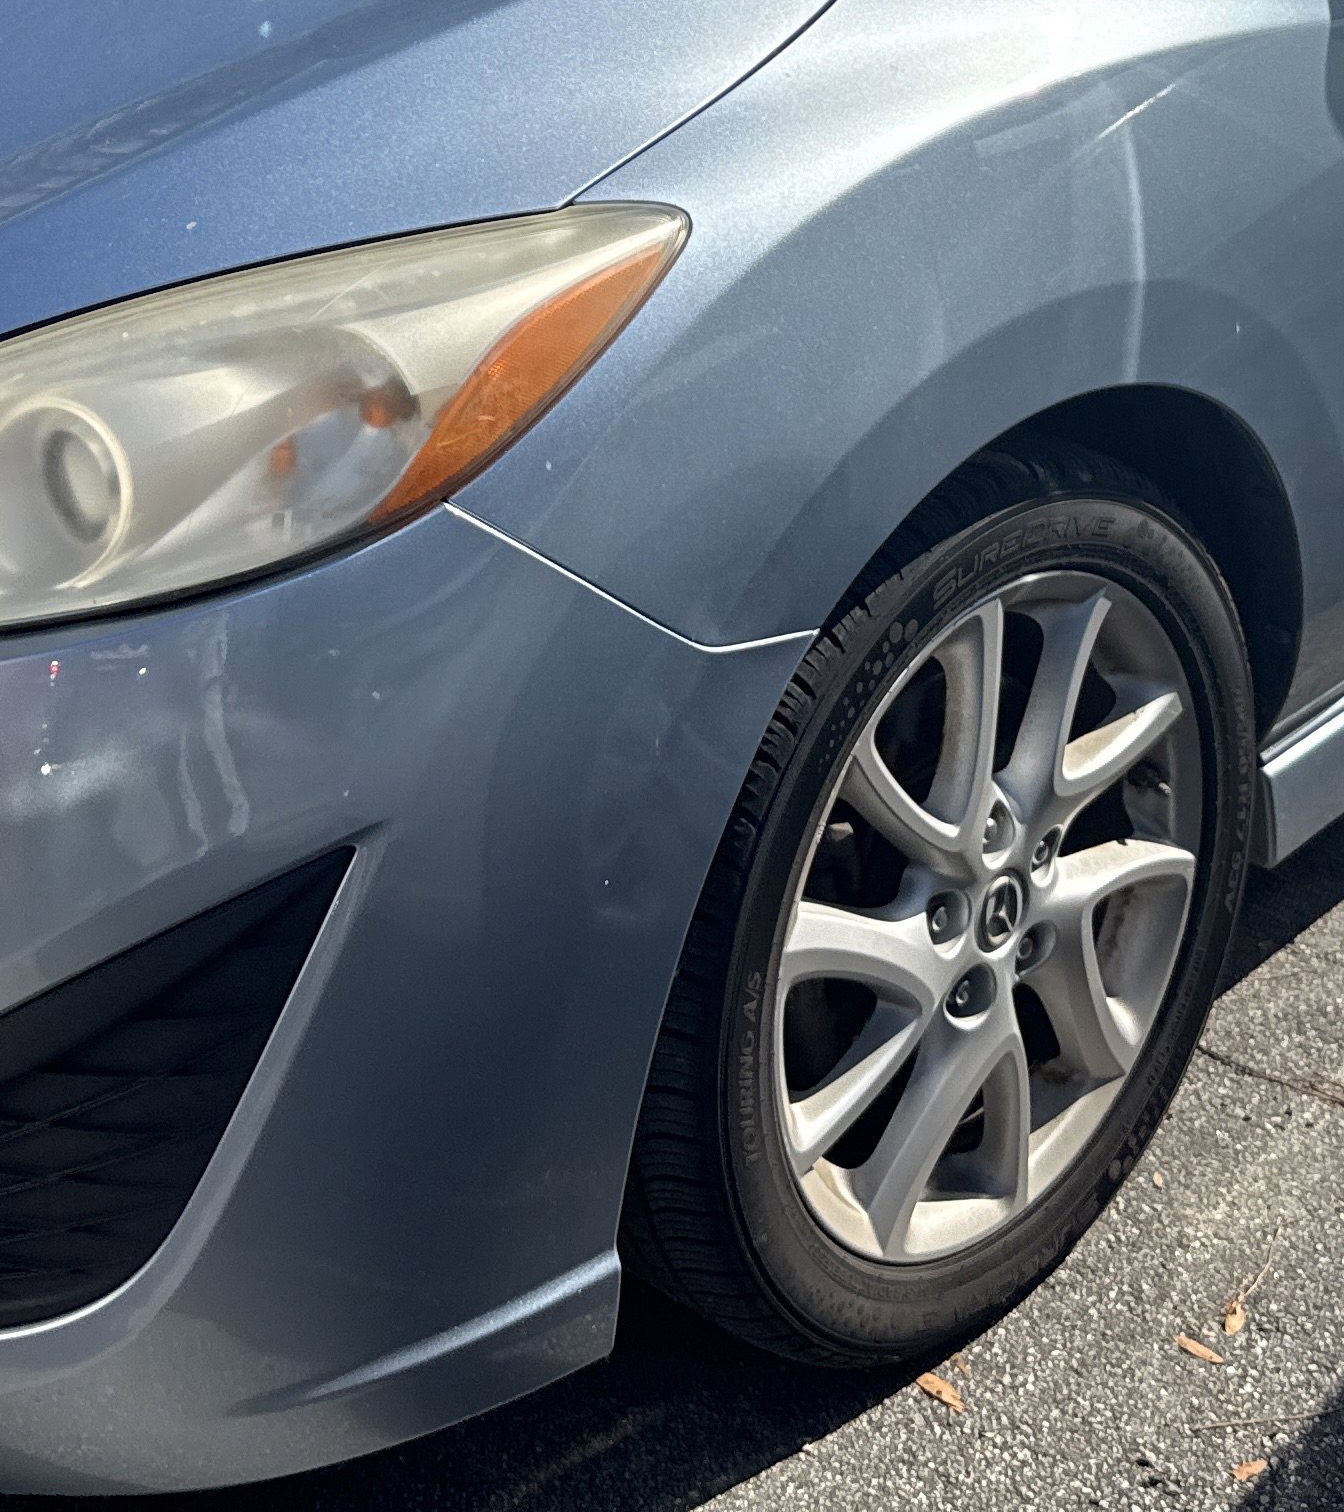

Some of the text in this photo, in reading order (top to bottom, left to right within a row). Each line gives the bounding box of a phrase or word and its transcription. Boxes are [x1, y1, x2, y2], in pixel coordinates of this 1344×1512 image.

[933, 515, 1116, 611] SUREDRIVE
[738, 970, 763, 1170] TOURING A/S
